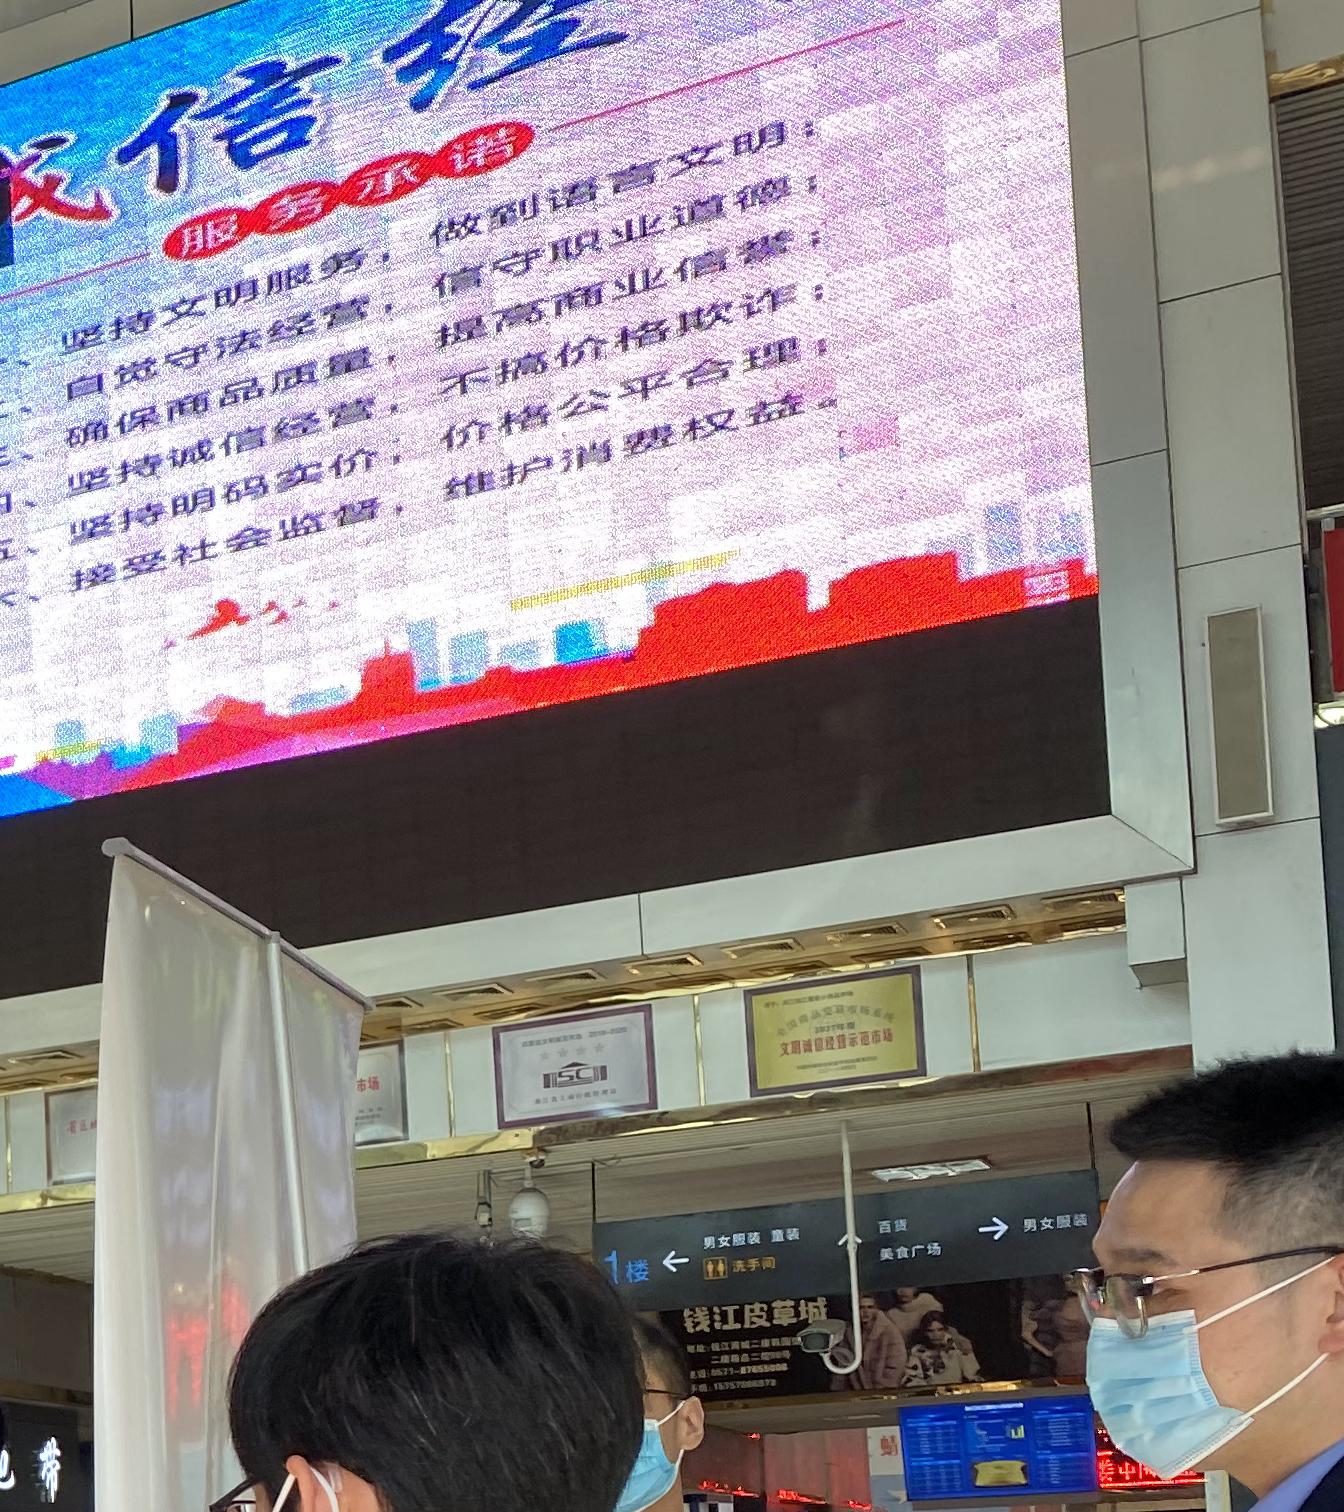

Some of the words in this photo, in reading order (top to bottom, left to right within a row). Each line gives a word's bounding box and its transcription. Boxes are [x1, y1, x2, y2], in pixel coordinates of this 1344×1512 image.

[176, 122, 519, 258] 服务承诺
[878, 1218, 909, 1234] 百货
[1022, 1213, 1089, 1233] 男女服装
[702, 1230, 761, 1249] 男女服装
[769, 1227, 801, 1243] 童装
[879, 1242, 942, 1262] 美食广场
[603, 1249, 650, 1285] 1楼
[731, 1256, 777, 1273] 洗手间
[683, 1297, 828, 1333] 钱江皮草城
